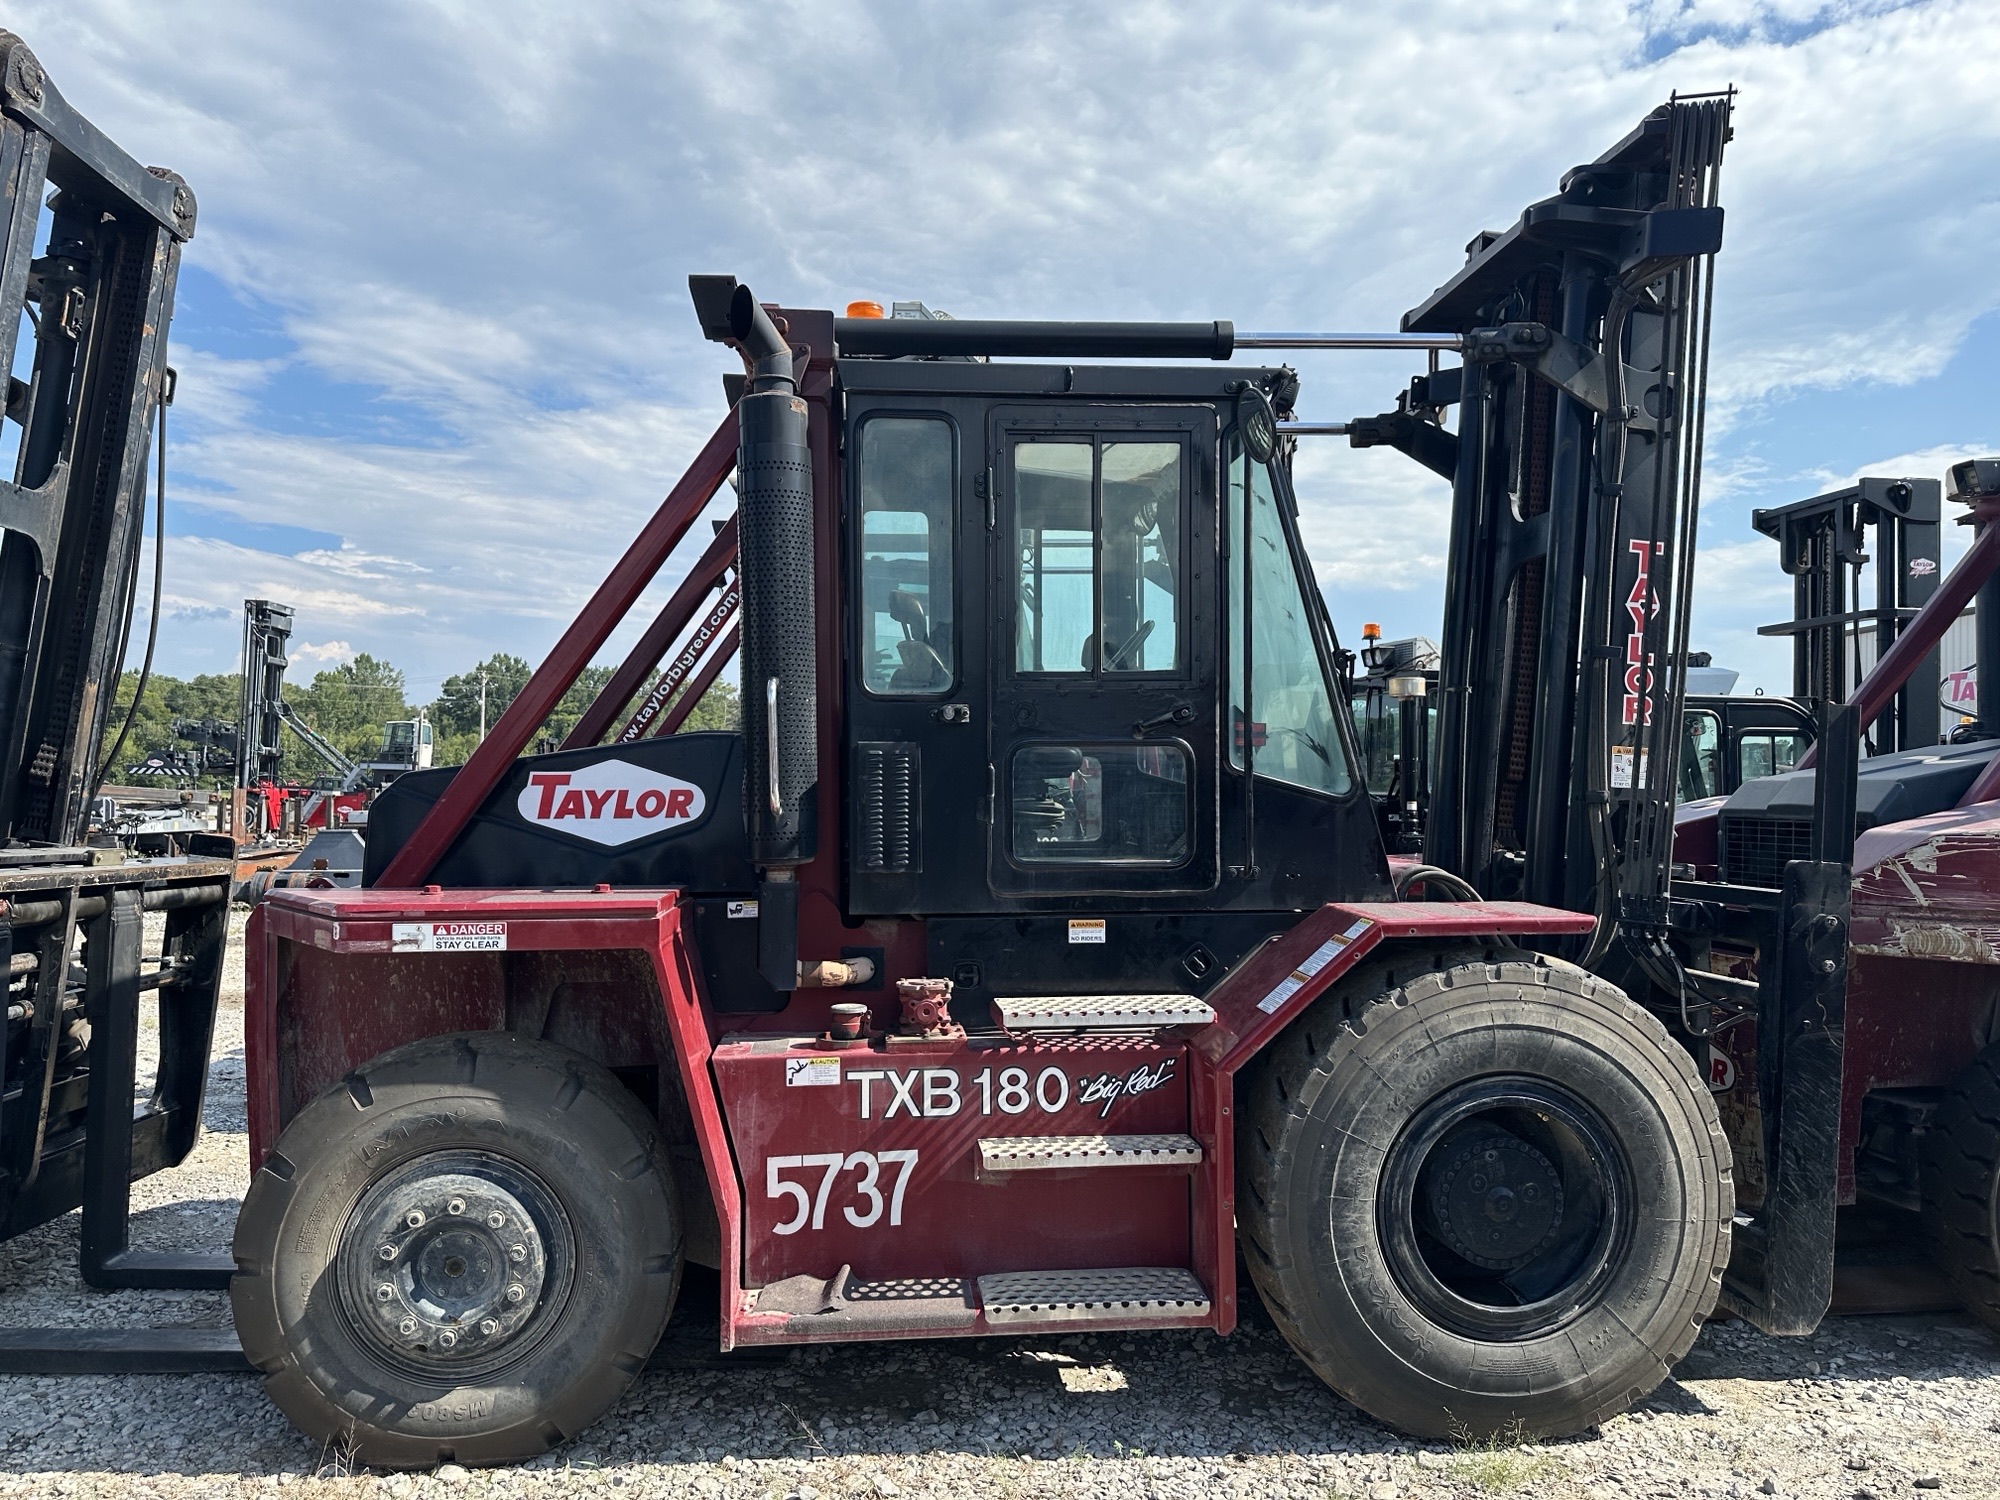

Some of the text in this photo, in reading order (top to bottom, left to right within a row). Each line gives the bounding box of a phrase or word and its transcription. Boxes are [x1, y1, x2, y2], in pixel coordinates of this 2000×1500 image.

[1624, 539, 1664, 726] TAYLOR
[531, 774, 694, 820] TAYLOR
[435, 940, 499, 949] STAY CLEAR
[450, 924, 503, 935] DANGER
[846, 1067, 962, 1119] TXB
[973, 1065, 1070, 1115] 180
[767, 1149, 919, 1236] 5737
[407, 1401, 487, 1421] MS803
